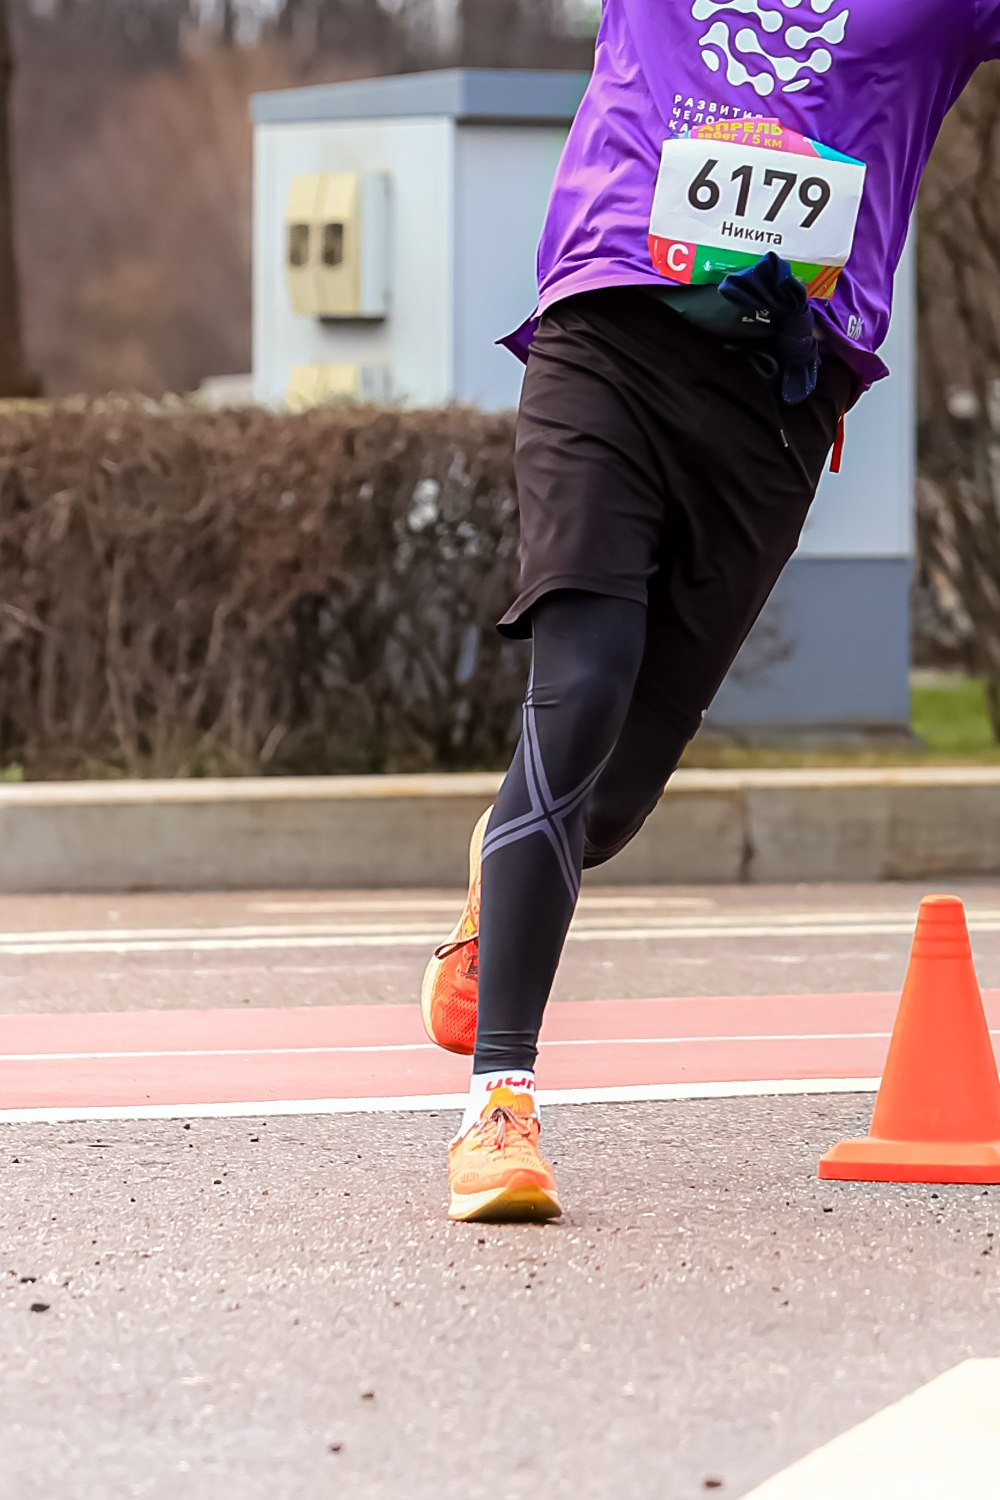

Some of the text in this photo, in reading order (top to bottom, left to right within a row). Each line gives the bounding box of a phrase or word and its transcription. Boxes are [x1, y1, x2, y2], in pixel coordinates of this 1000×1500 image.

[752, 134, 761, 145] 5
[687, 158, 832, 229] 6179
[721, 221, 783, 246] Никита
